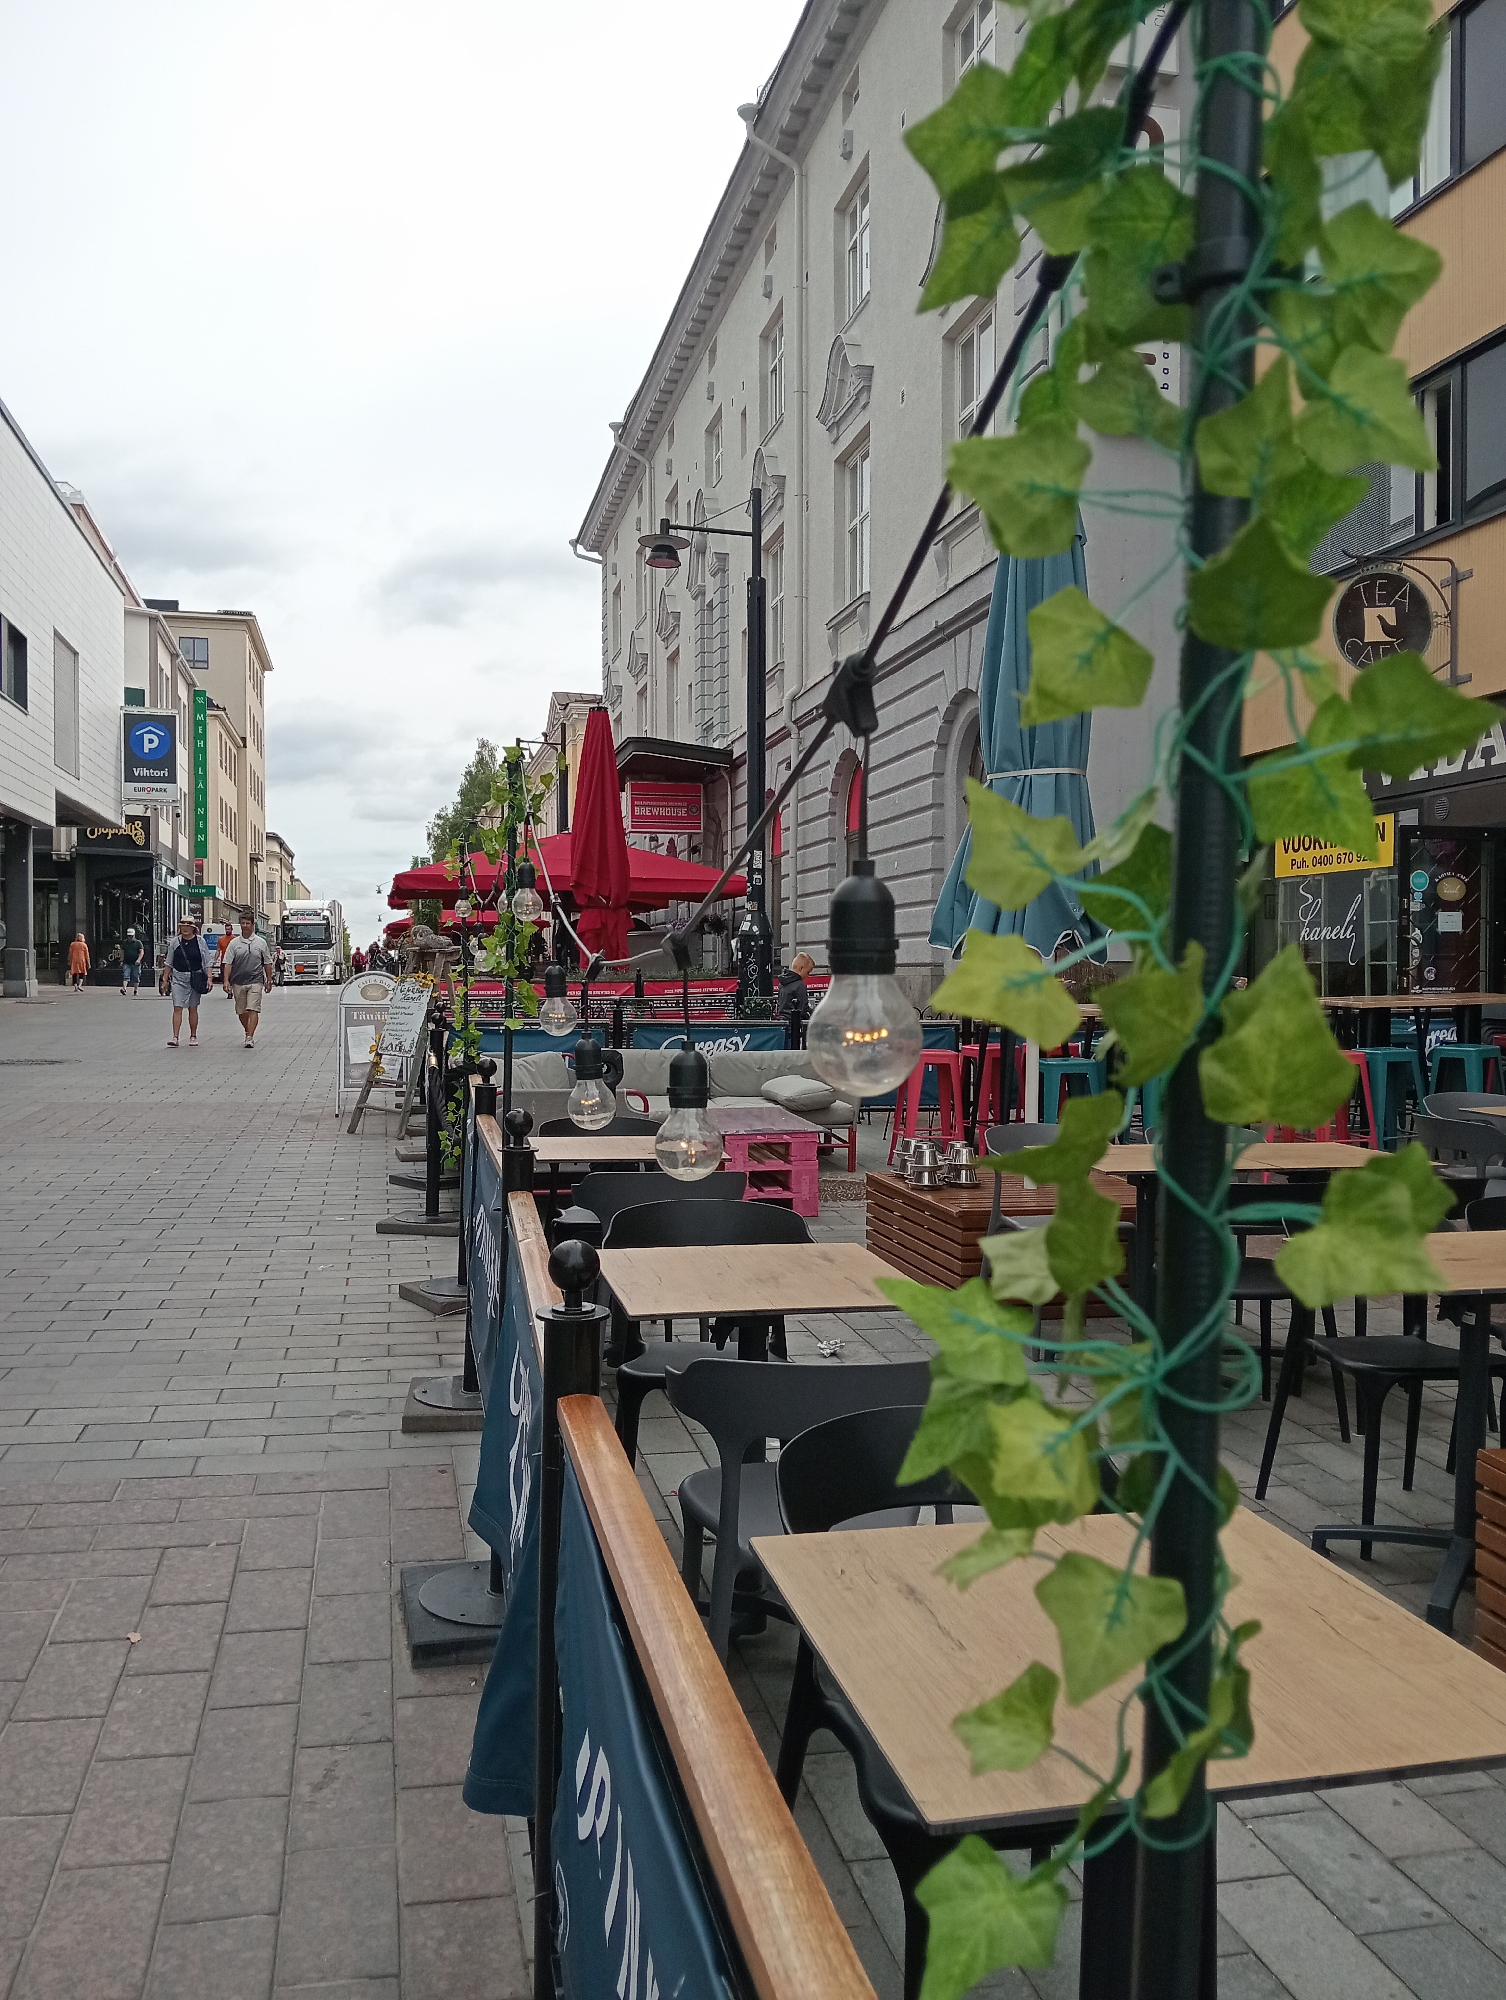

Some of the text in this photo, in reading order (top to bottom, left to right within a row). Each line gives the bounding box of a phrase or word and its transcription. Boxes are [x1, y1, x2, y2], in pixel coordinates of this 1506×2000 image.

[1160, 340, 1170, 390] baa
[1353, 578, 1410, 613] TEA
[143, 733, 160, 754] P
[132, 767, 169, 777] Vihtori
[196, 713, 205, 842] MEHILÄINEN
[133, 786, 168, 794] EUROPARK
[634, 806, 688, 816] BREWHOUSE
[1282, 821, 1386, 854] VUOKN
[1290, 857, 1309, 870] Puh.
[1311, 853, 1334, 867] 0400
[1336, 851, 1354, 864] 670
